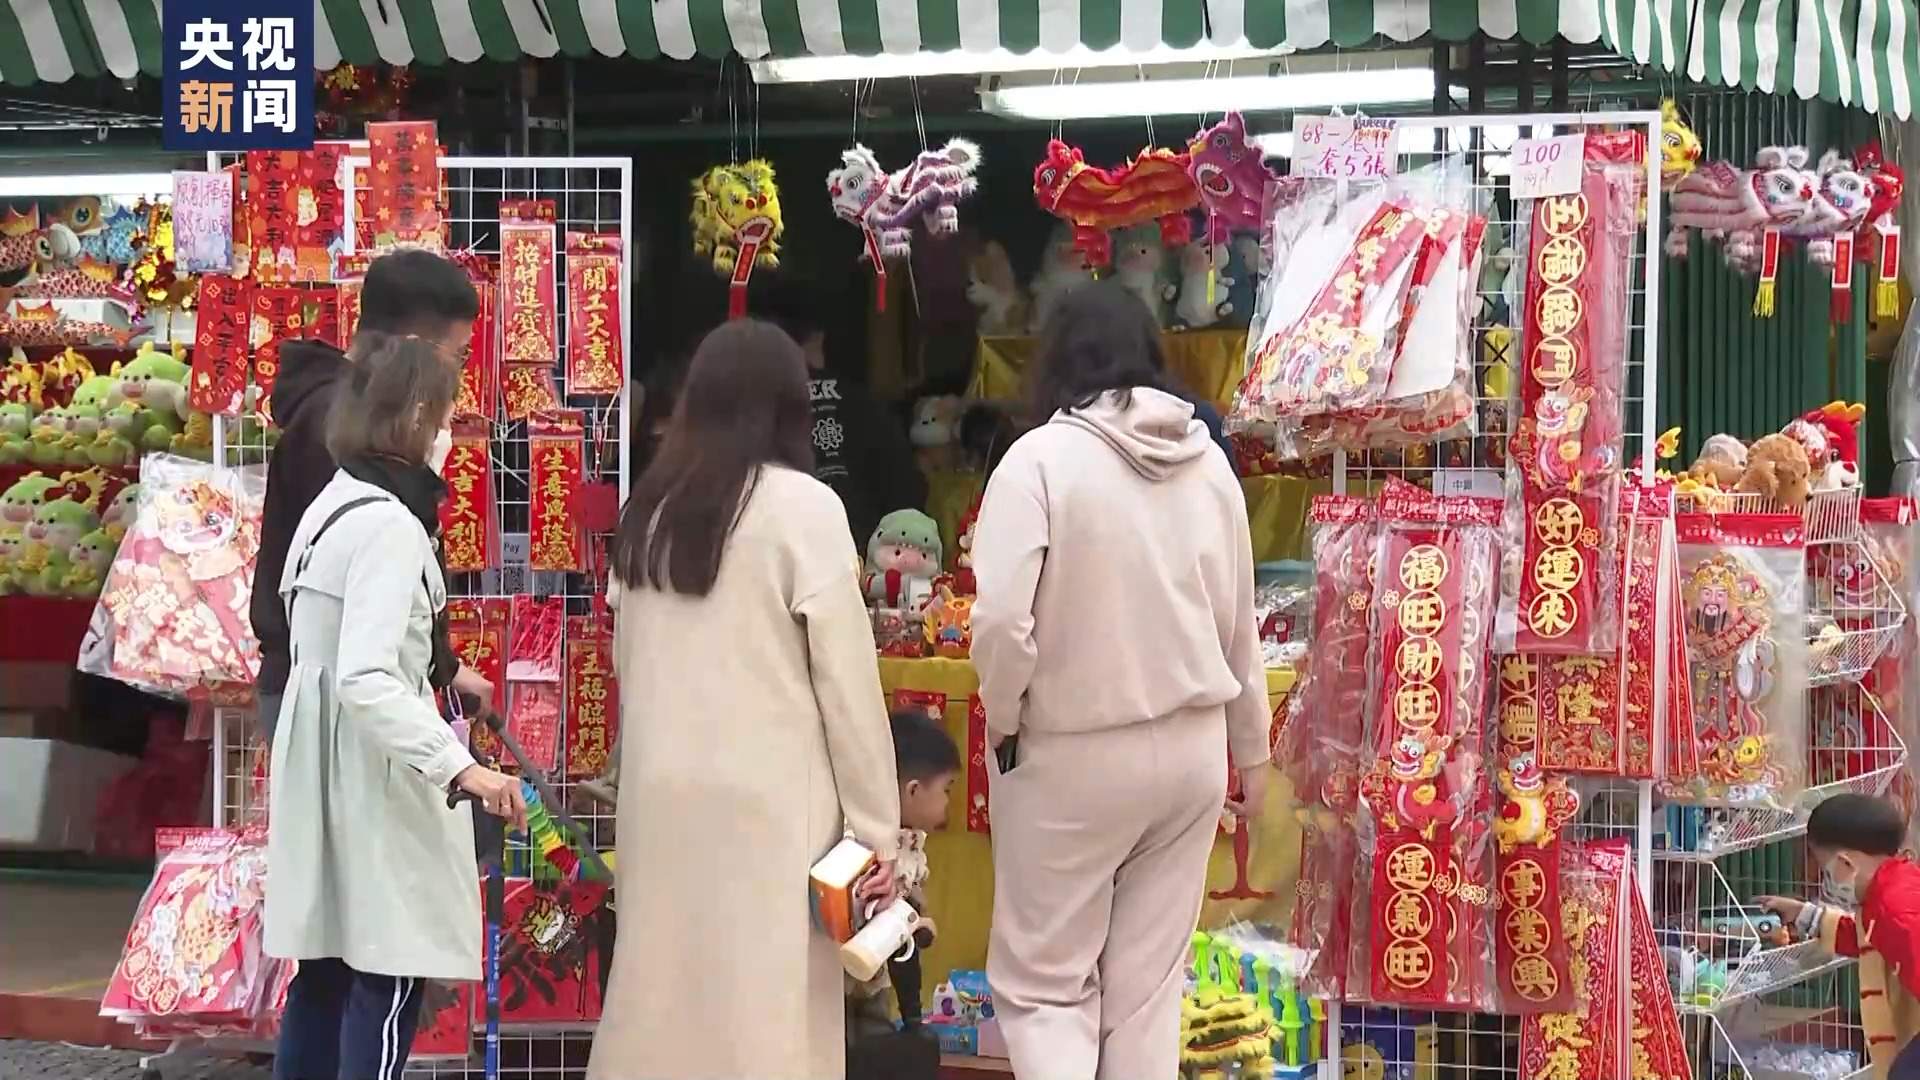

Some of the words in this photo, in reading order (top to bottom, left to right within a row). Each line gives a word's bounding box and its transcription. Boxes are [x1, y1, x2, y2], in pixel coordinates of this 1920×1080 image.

[263, 153, 285, 247] 大吉大利
[1518, 142, 1561, 166] 100
[807, 379, 842, 401] ER
[447, 447, 479, 545] 大吉大利
[539, 447, 570, 546] 生意興隆
[1531, 500, 1582, 636] 好運來
[1397, 546, 1446, 728] 福旺財旺
[577, 651, 608, 746] 五福臨門
[1386, 846, 1433, 985] 運氣旺
[1503, 861, 1557, 1000] 事業興
